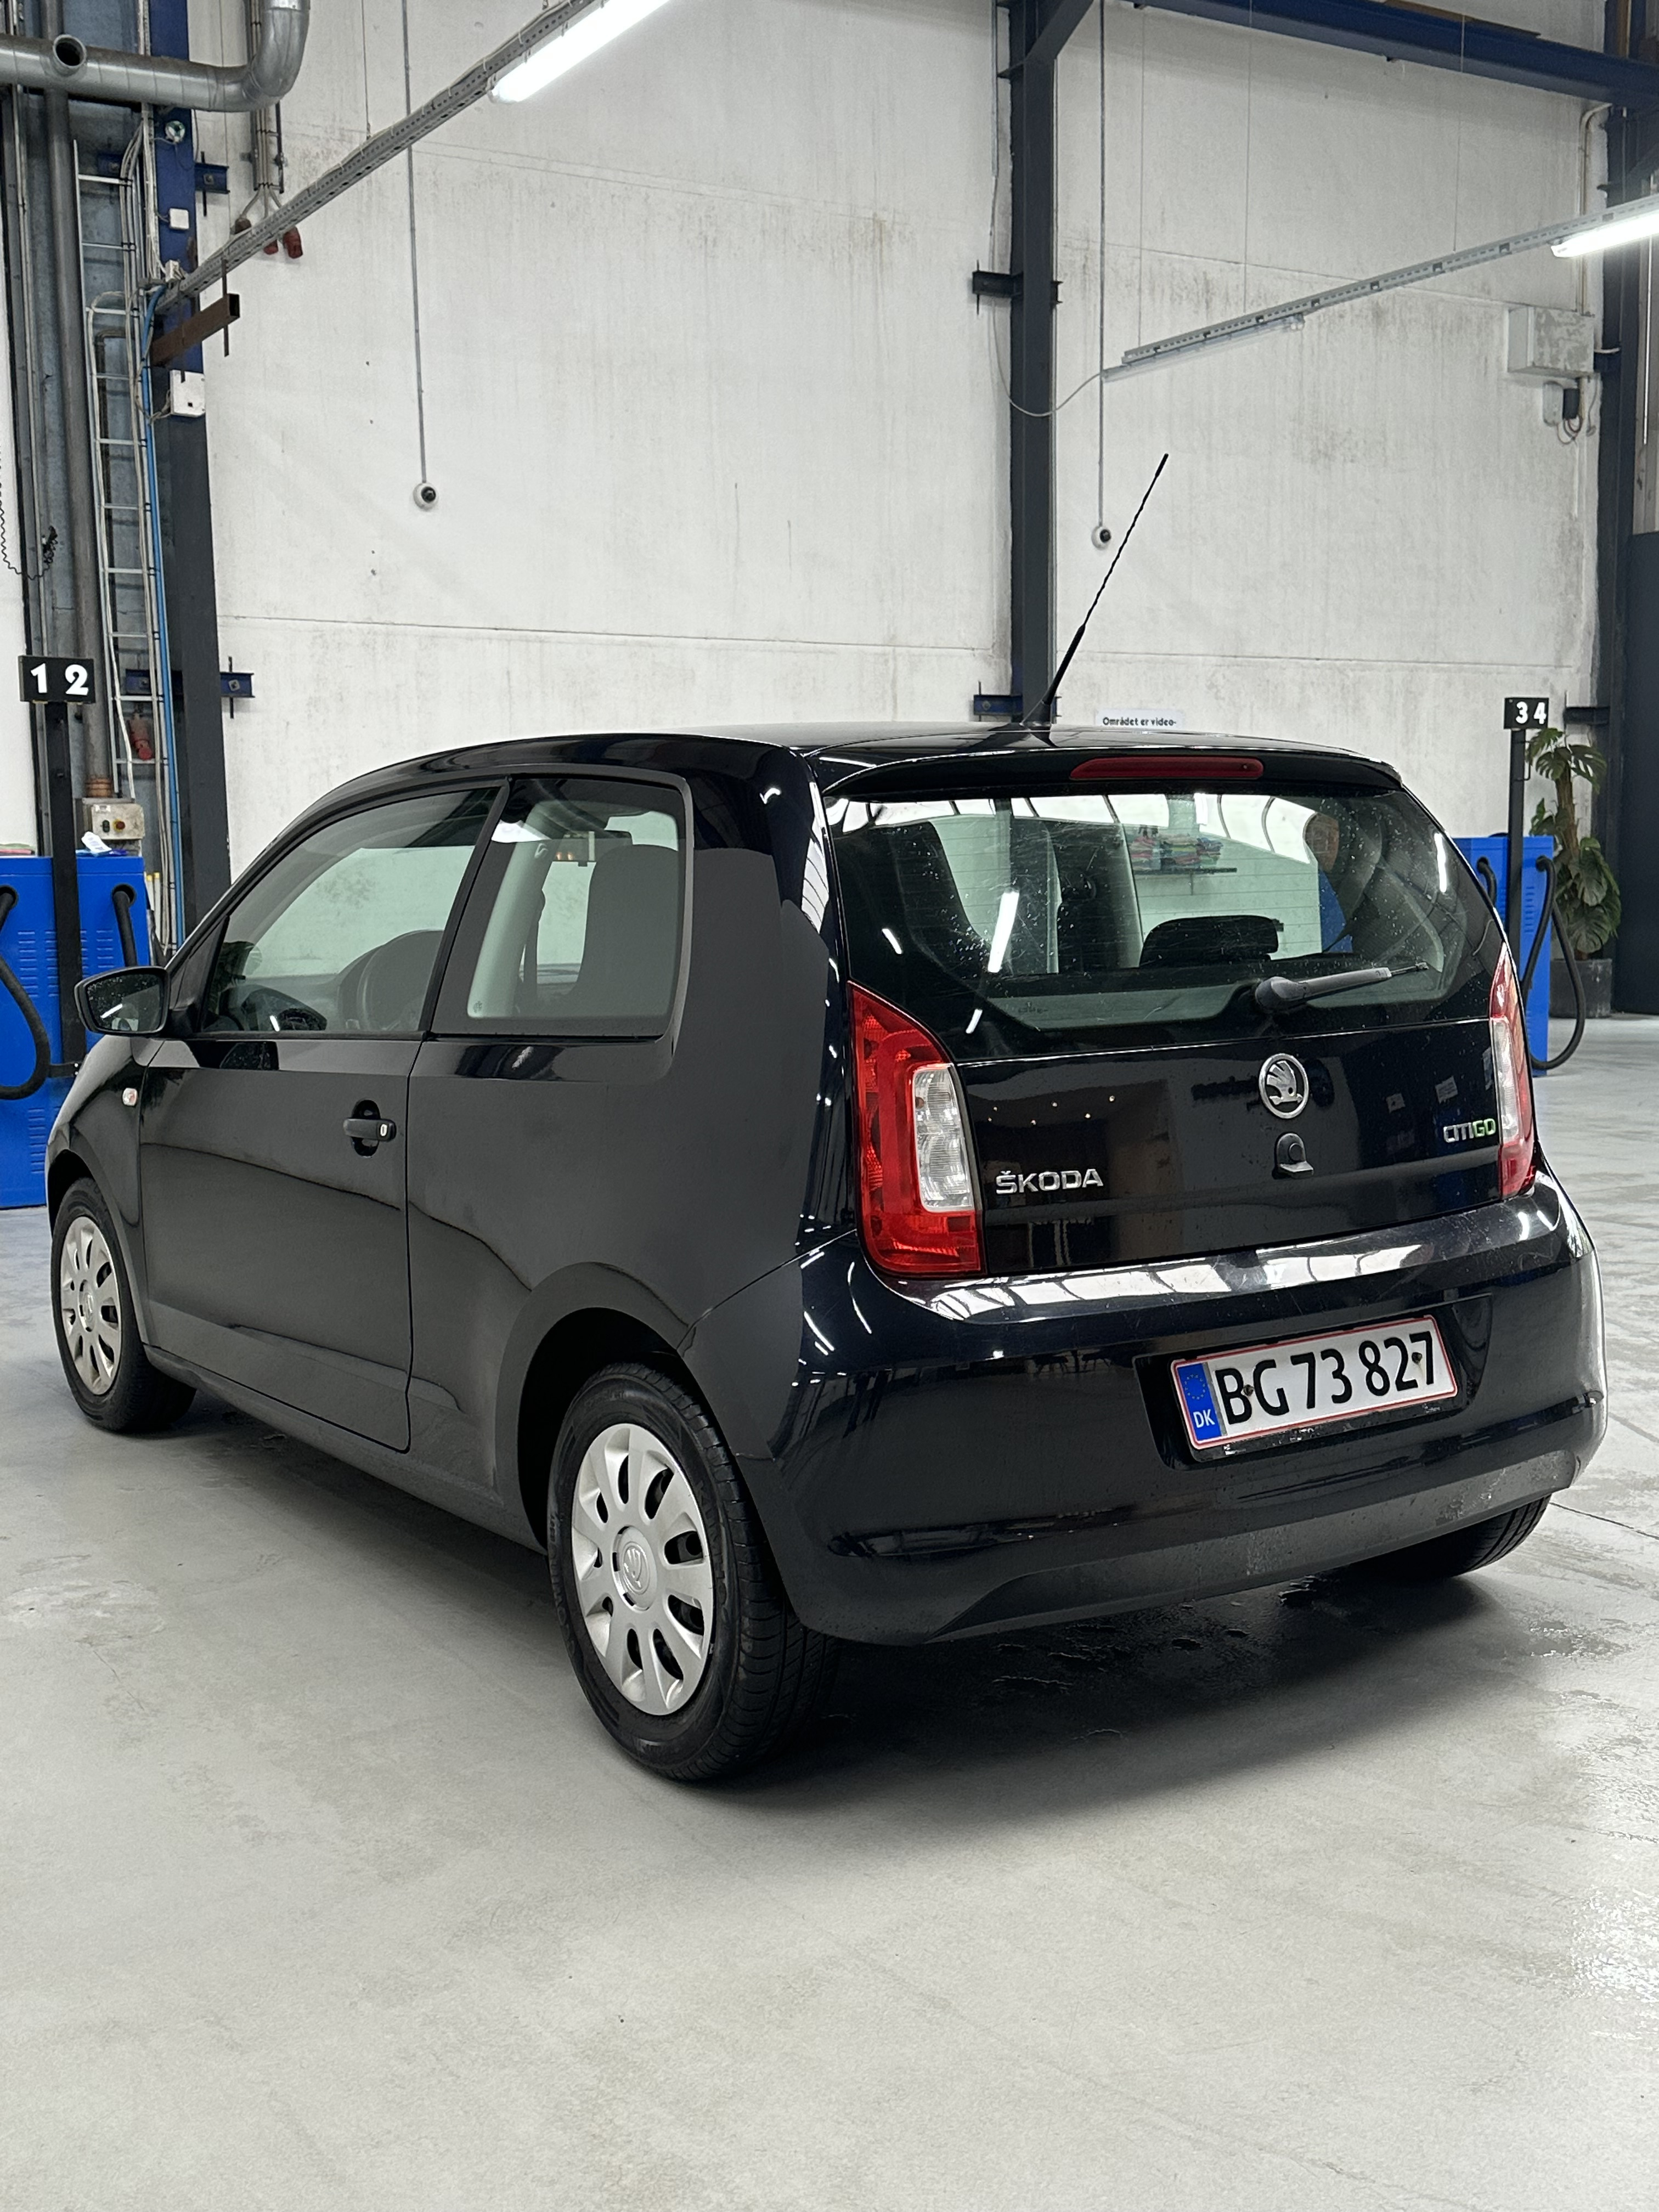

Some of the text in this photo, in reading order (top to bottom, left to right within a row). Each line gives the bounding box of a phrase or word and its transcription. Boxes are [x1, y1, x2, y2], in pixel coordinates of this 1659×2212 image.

[30, 663, 89, 696] 1 2
[1103, 716, 1138, 726] Området
[1151, 716, 1176, 726] video-
[1515, 701, 1547, 724] 3 4
[1443, 1118, 1496, 1143] CITIGO
[996, 1169, 1104, 1195] ŠKODA
[1215, 1331, 1435, 1425] BG 73 827
[1193, 1409, 1215, 1429] DK
